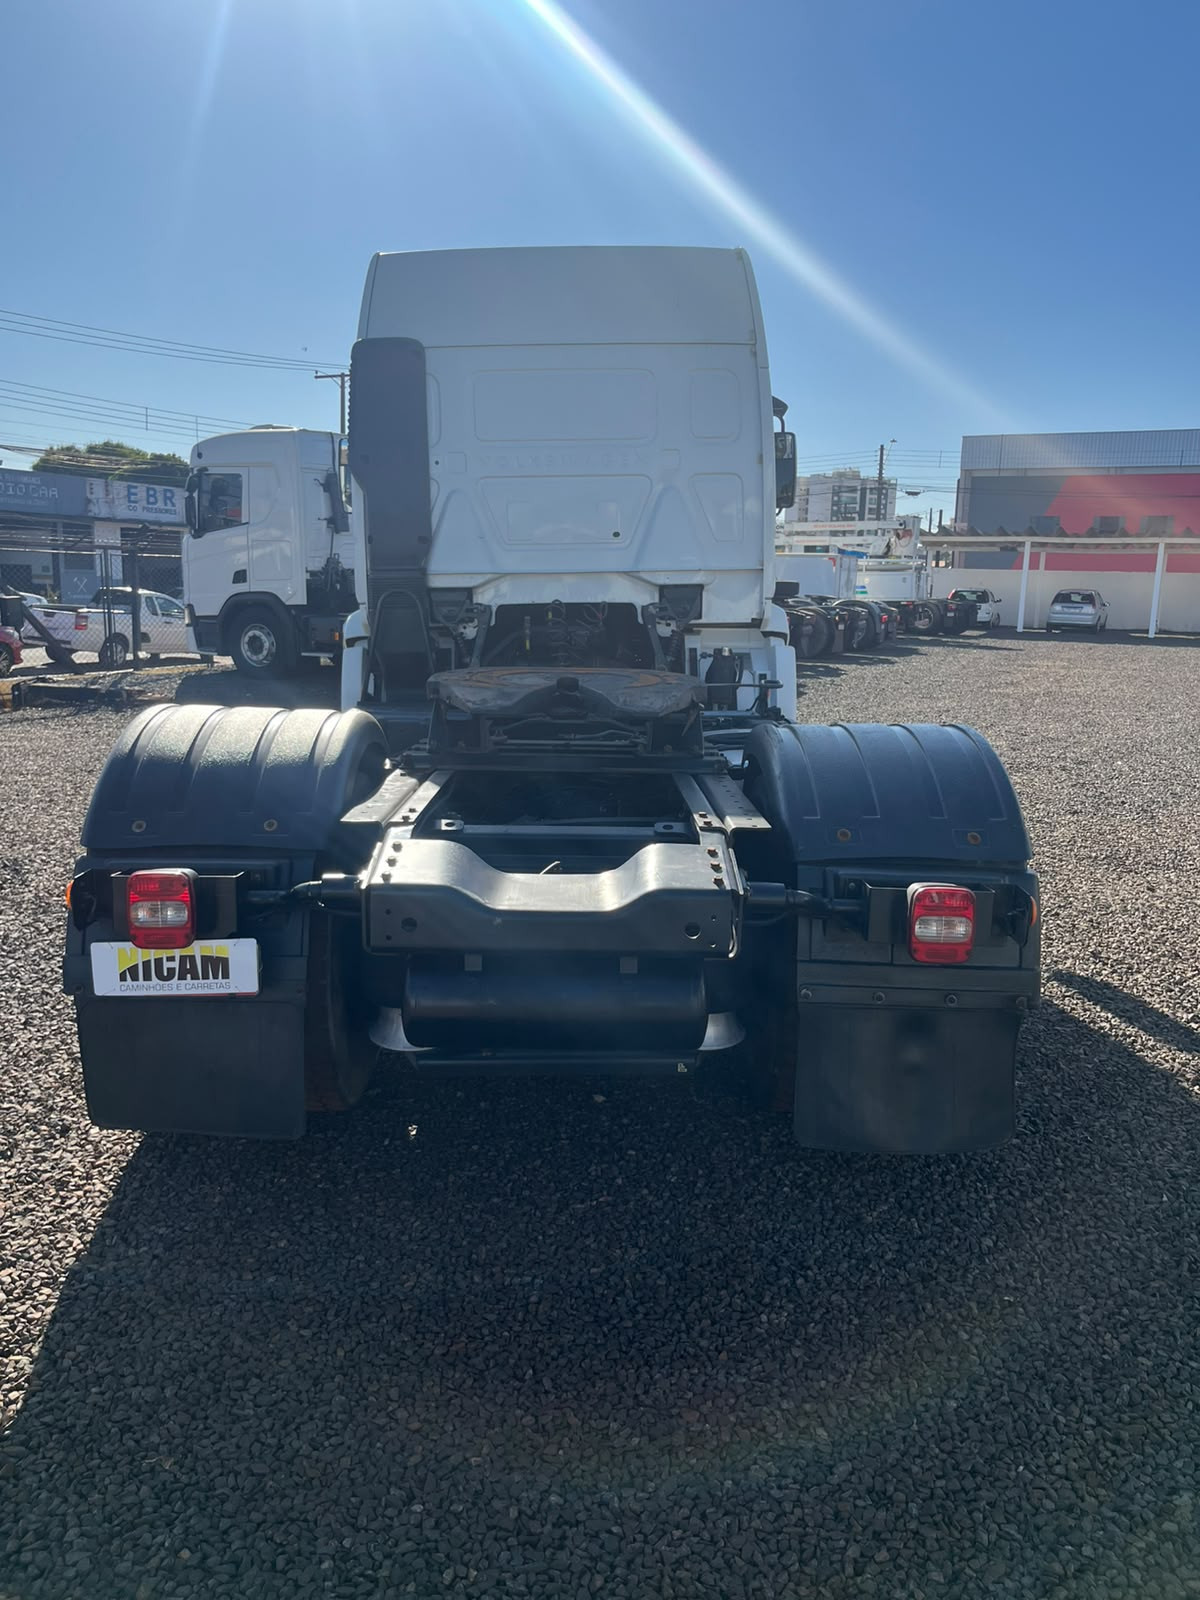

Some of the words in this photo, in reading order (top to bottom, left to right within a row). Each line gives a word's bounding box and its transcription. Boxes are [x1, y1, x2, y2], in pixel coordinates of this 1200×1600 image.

[127, 484, 176, 507] EBR
[117, 945, 230, 982] NICAM
[119, 981, 174, 993] CAMINHÕES
[176, 983, 182, 991] E
[185, 982, 231, 991] CARRETAS
